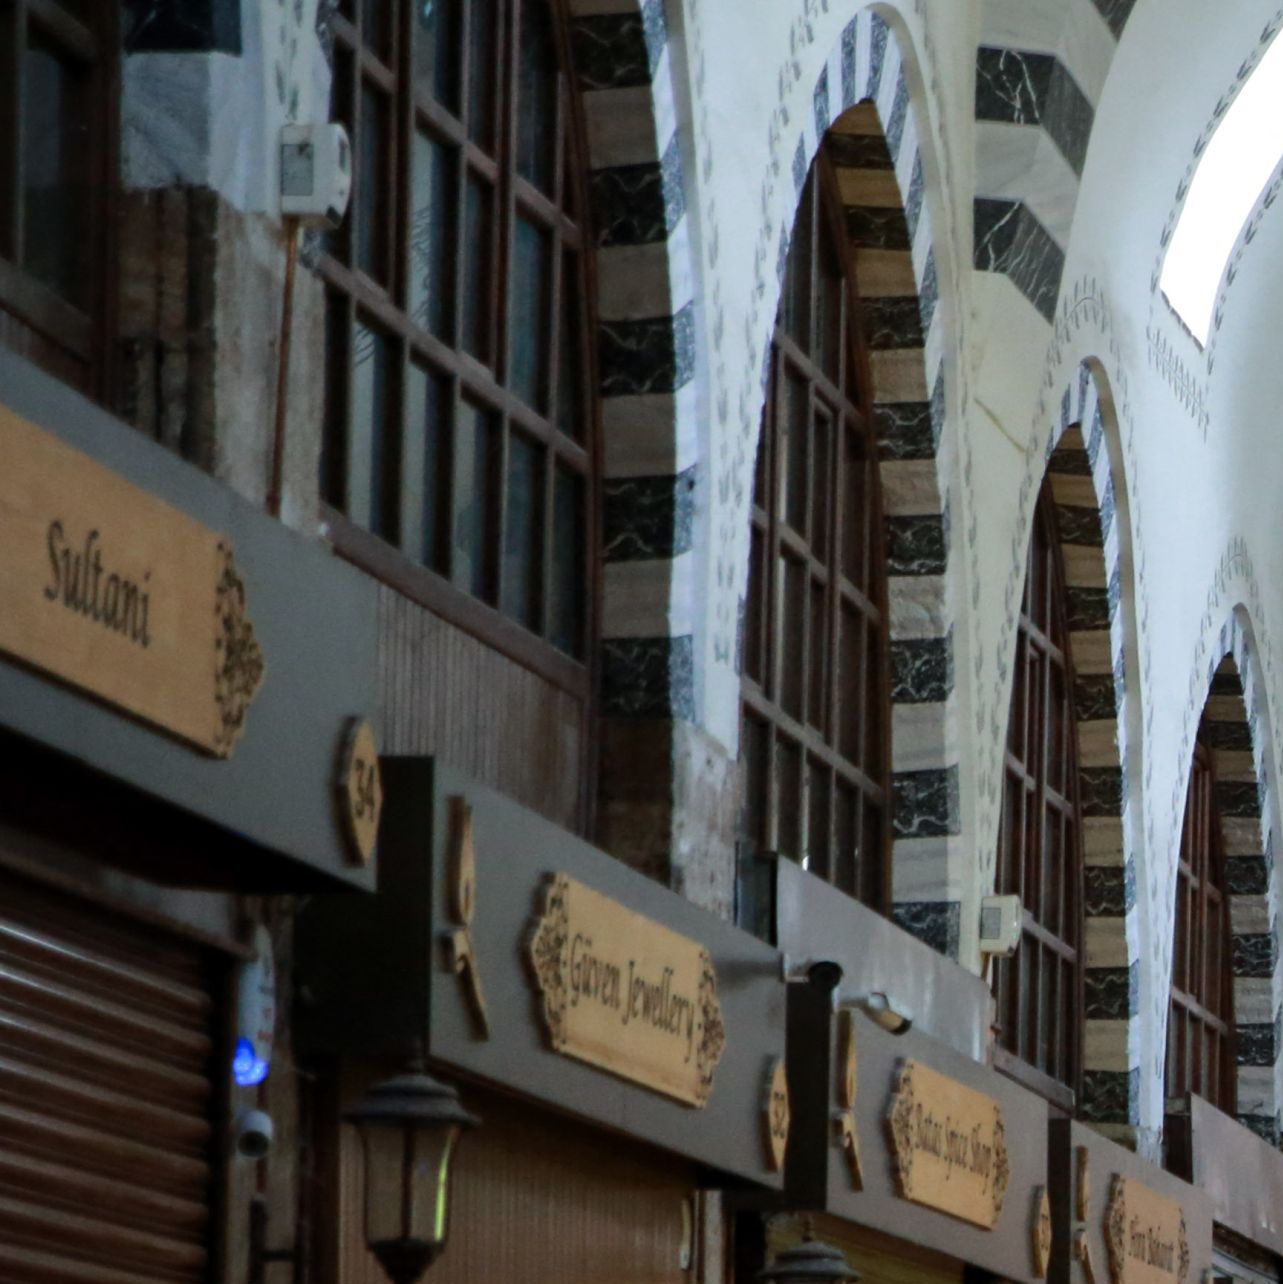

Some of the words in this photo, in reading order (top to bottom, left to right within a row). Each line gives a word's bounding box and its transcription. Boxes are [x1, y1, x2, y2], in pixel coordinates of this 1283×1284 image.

[44, 520, 150, 648] Sultani
[356, 759, 375, 822] 34
[569, 933, 620, 1008] Güven
[622, 960, 695, 1063] Jewellery
